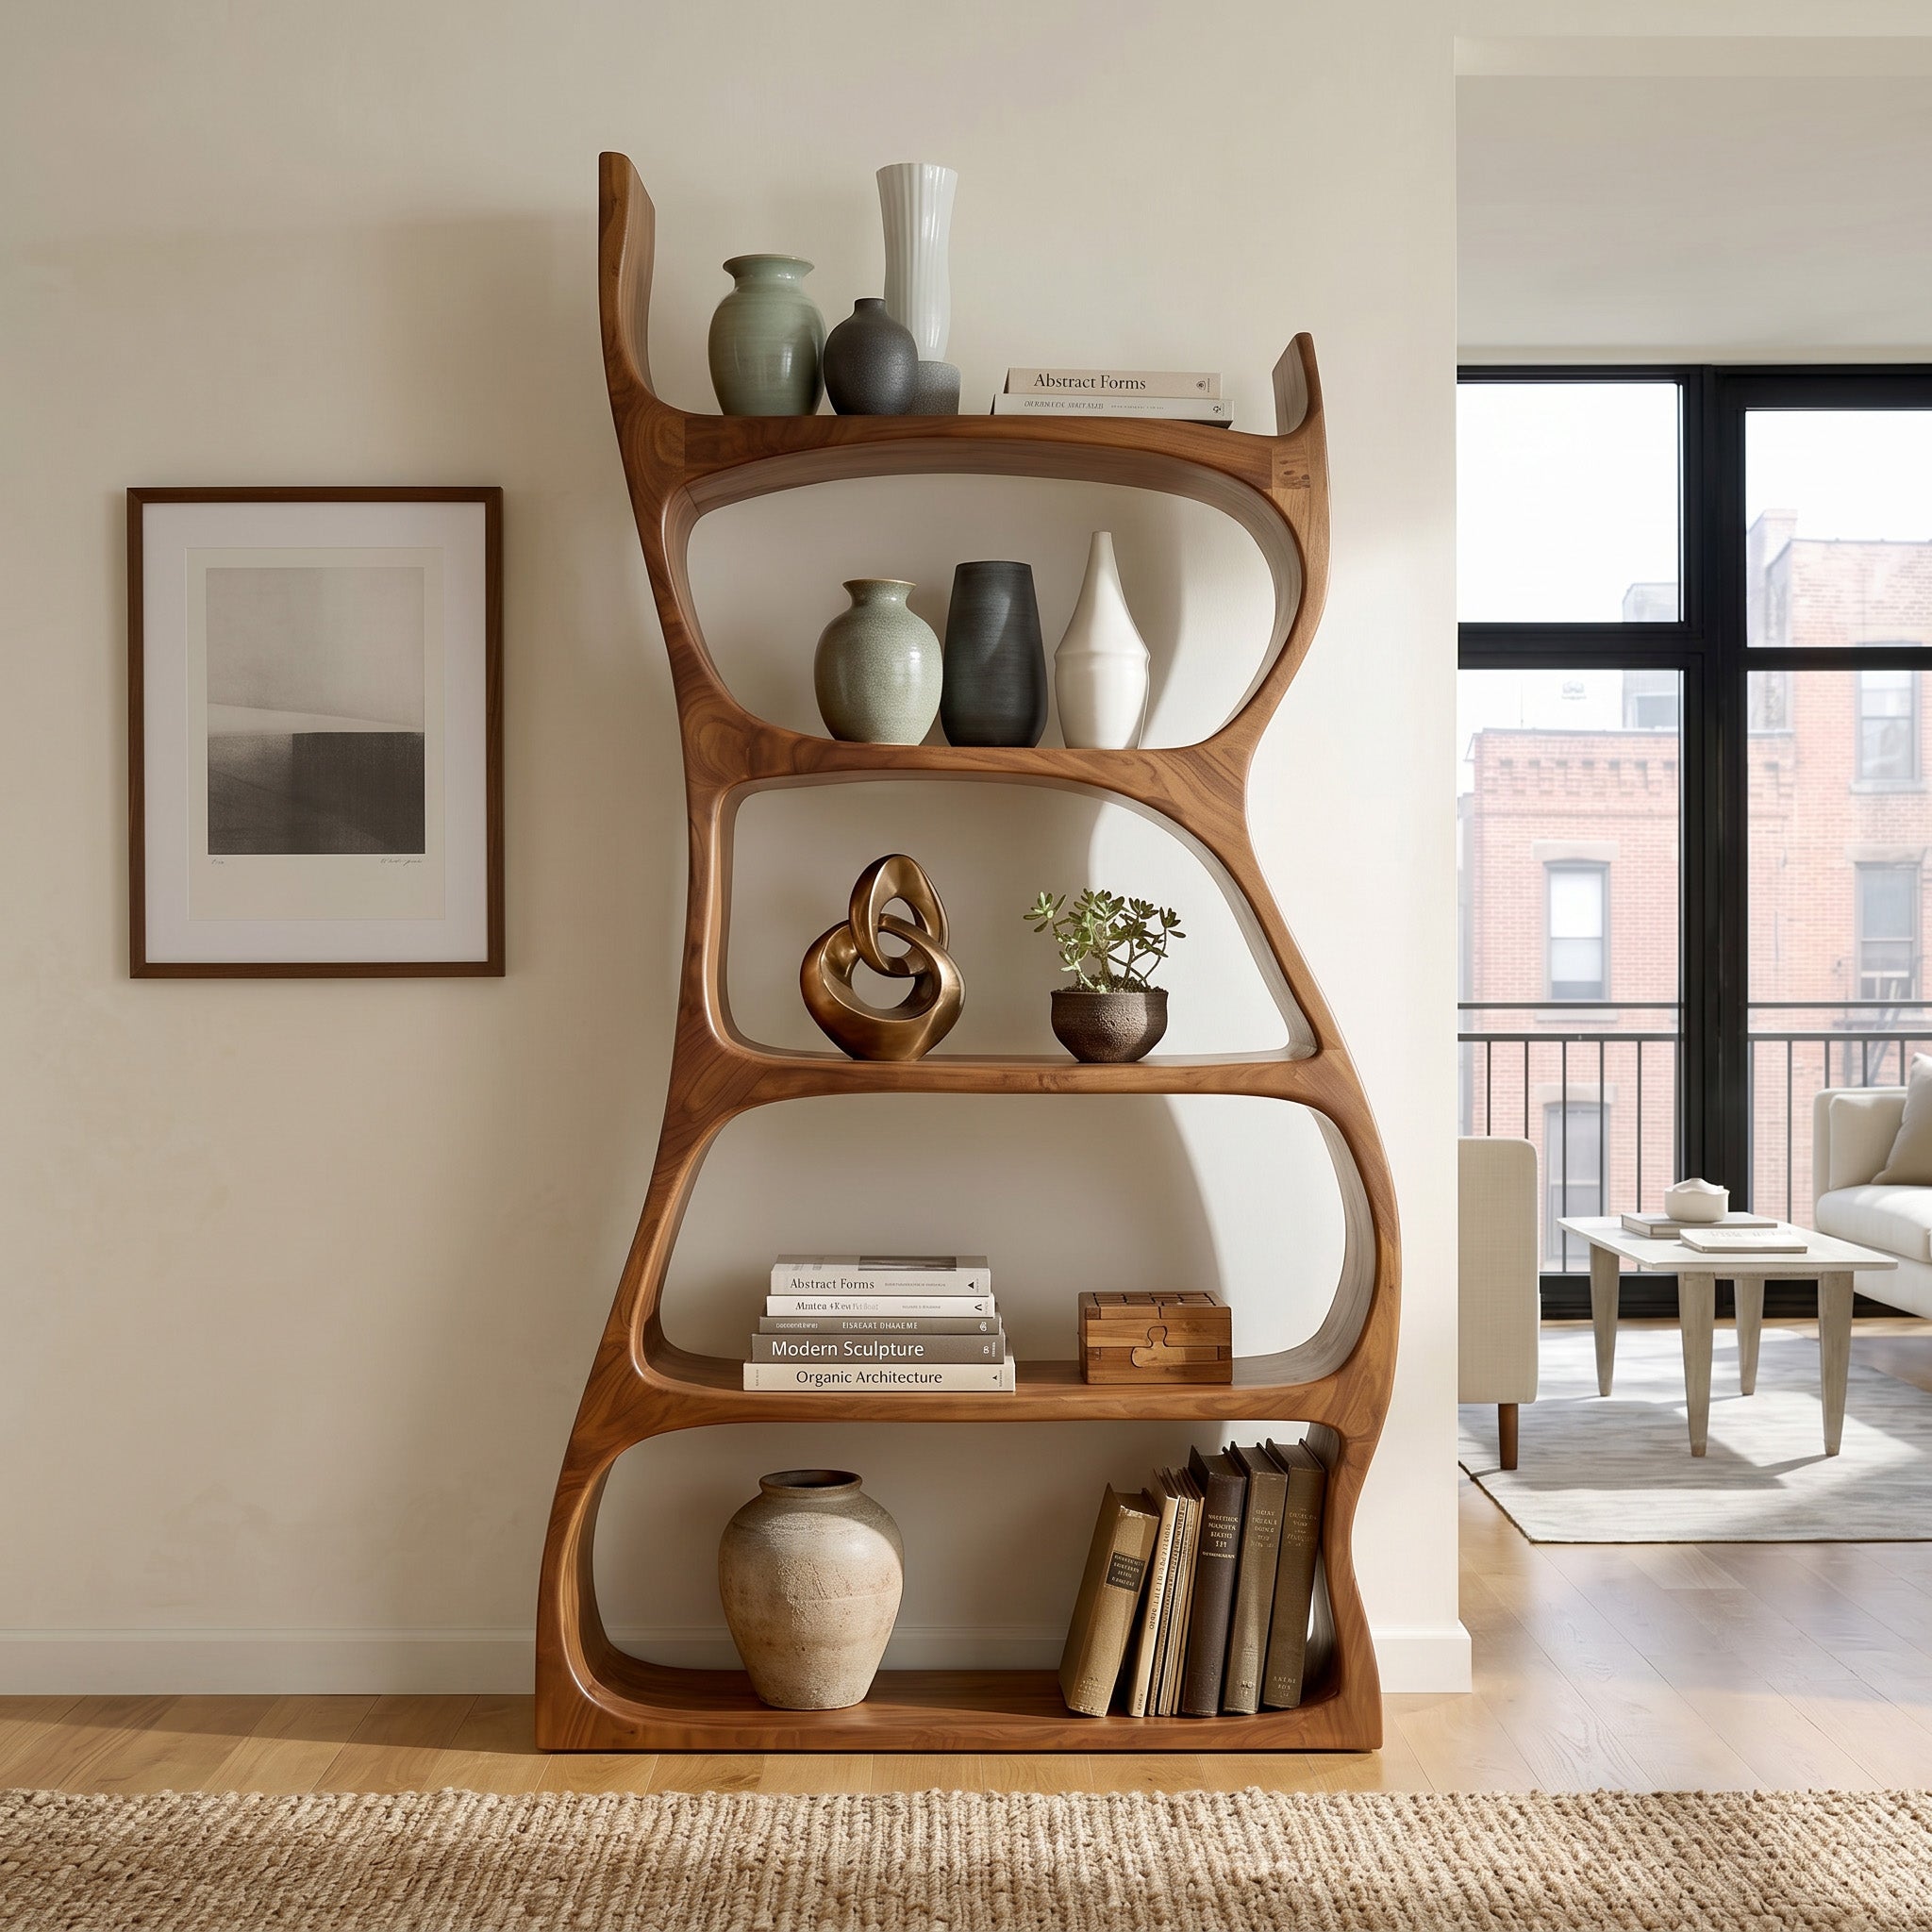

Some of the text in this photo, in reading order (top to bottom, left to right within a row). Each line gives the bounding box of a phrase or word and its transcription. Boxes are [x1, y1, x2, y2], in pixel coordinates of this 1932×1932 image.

[1034, 374, 1146, 391] Abstract Forms
[790, 1277, 837, 1290] Abstract
[841, 1277, 874, 1290] Forms
[772, 1341, 924, 1360] Modern Sculpture
[795, 1370, 943, 1388] Organic Architecture
